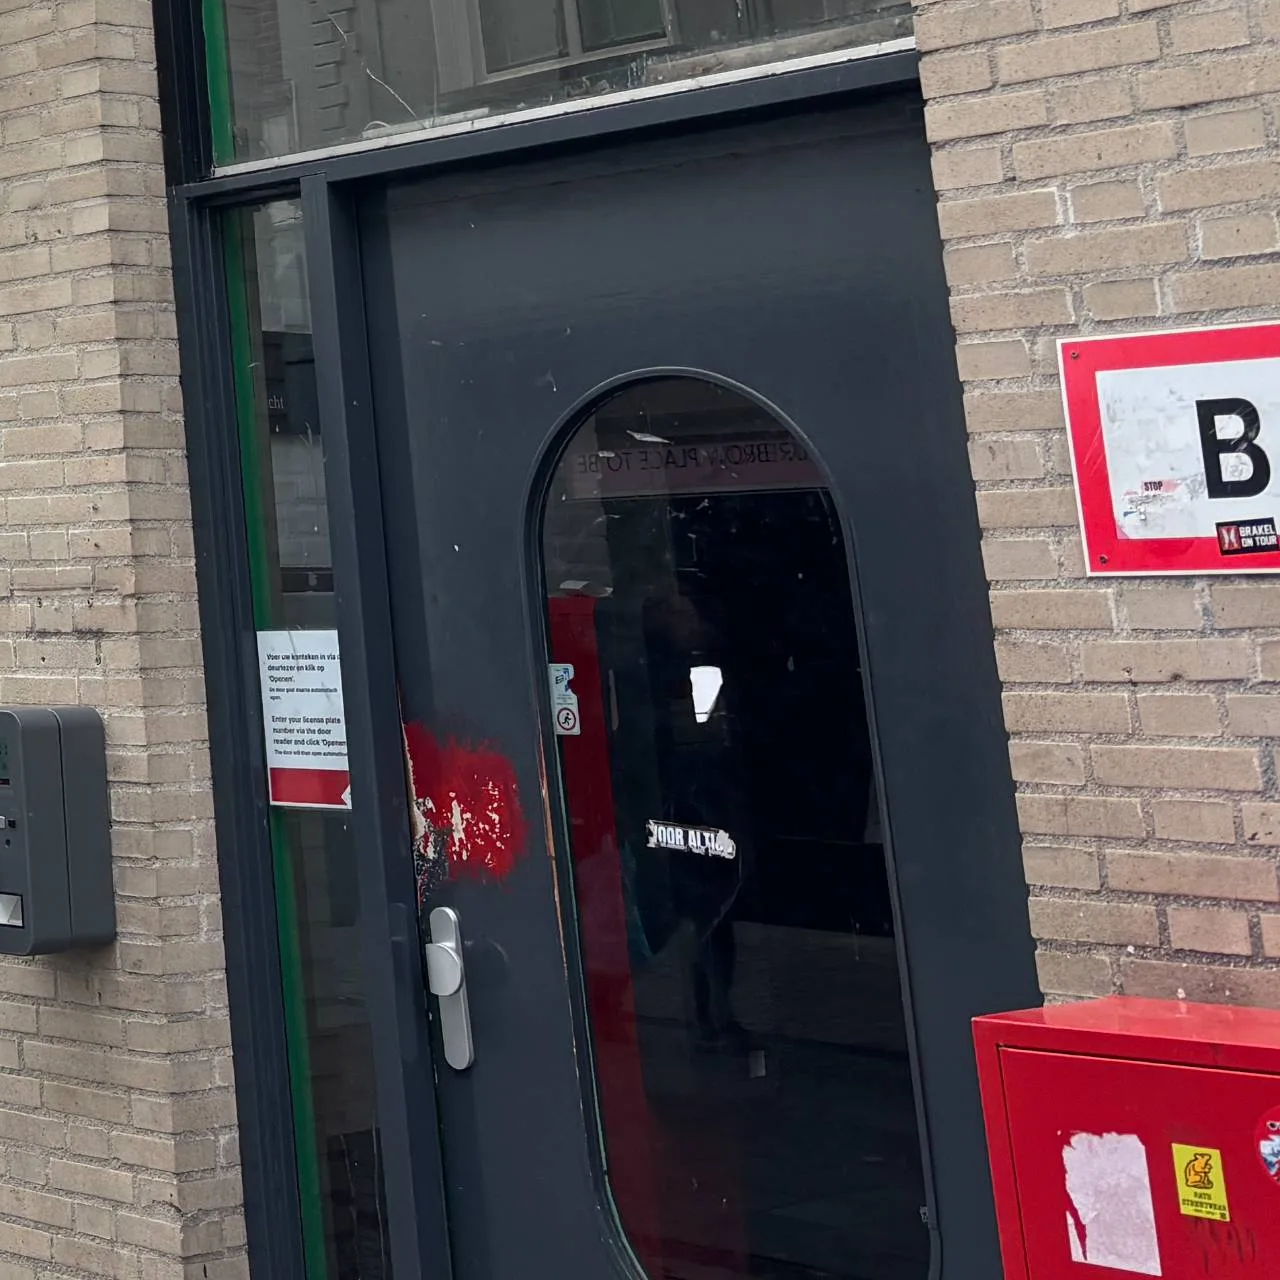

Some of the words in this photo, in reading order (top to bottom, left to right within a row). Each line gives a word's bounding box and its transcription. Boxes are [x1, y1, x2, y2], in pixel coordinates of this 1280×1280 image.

[1195, 397, 1271, 500] B
[1143, 480, 1164, 492] STOP
[1239, 523, 1276, 537] BRAKEL
[1241, 536, 1255, 548] ON
[1255, 534, 1277, 547] TOUR
[317, 665, 325, 673] op
[271, 715, 287, 723] Enter
[288, 717, 302, 725] your
[325, 717, 341, 725] plate
[306, 738, 321, 746] click
